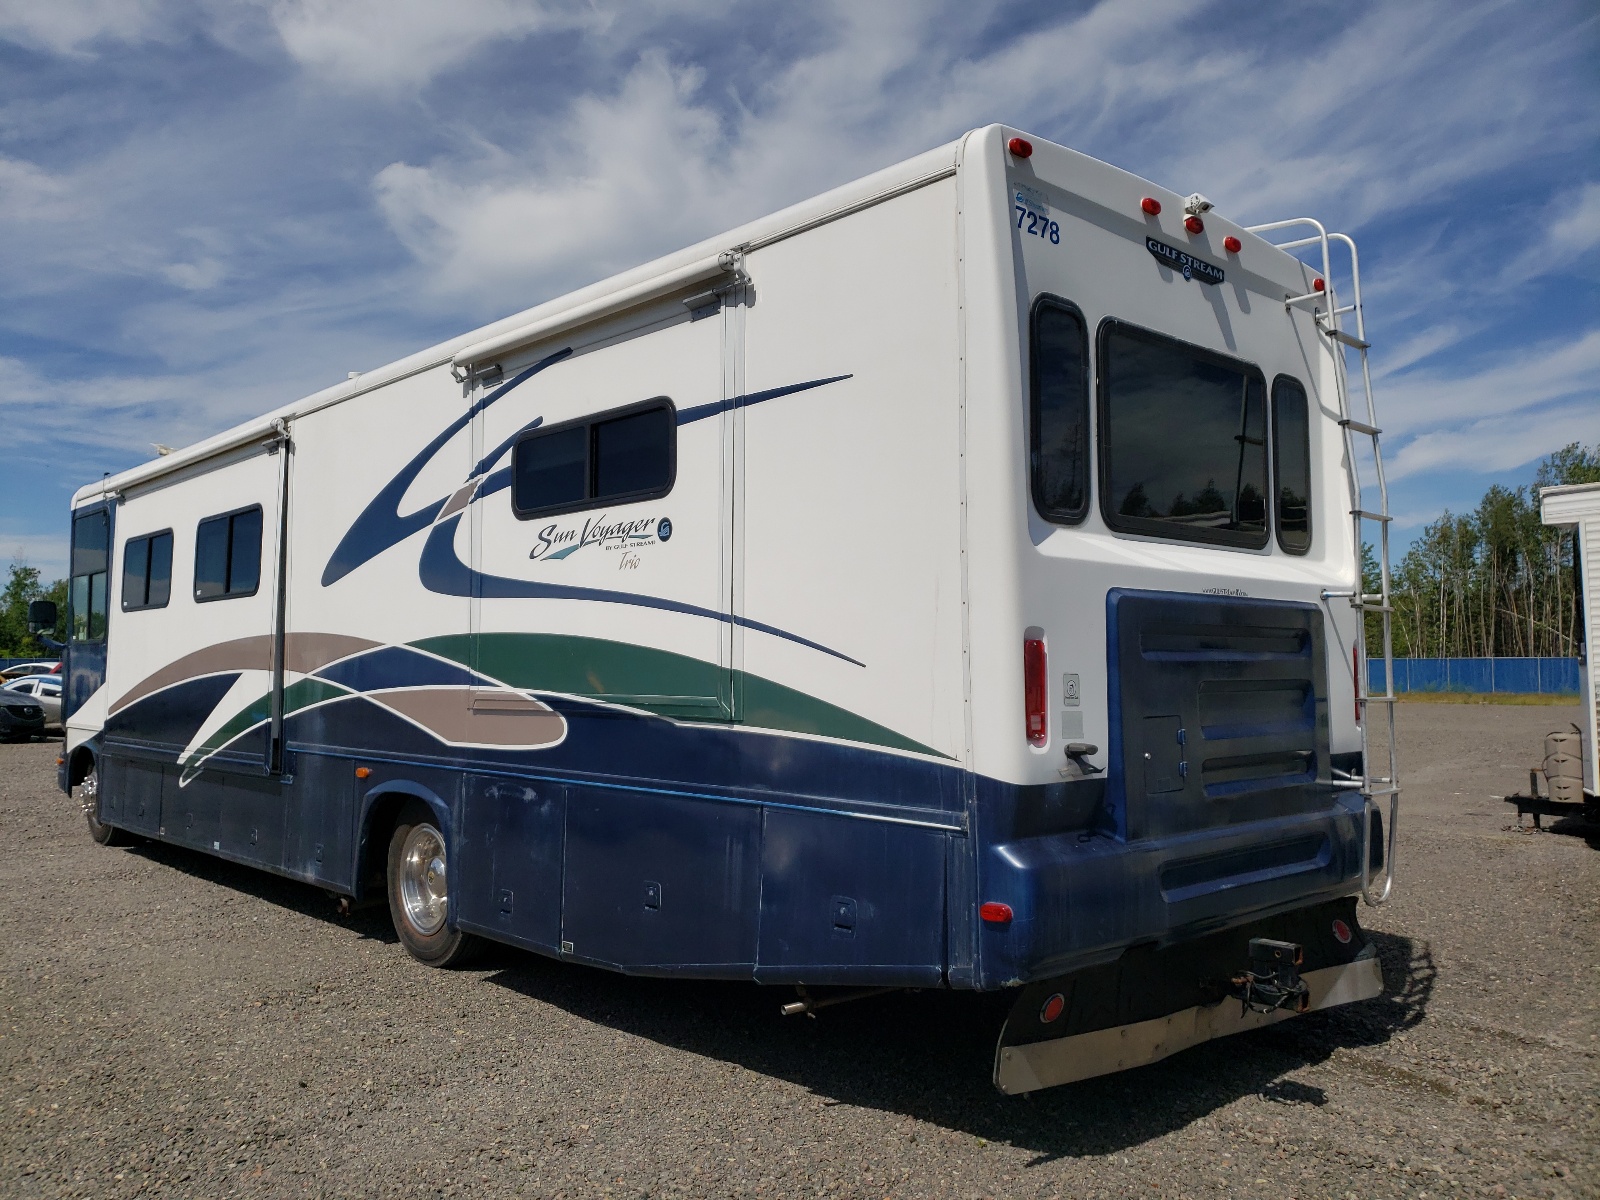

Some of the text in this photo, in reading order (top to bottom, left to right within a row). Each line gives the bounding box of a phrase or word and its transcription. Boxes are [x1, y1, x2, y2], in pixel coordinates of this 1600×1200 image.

[1015, 205, 1060, 245] 7278
[1148, 240, 1223, 280] GULF STREAM
[529, 514, 656, 559] Sun Voyager
[619, 550, 641, 570] Trio
